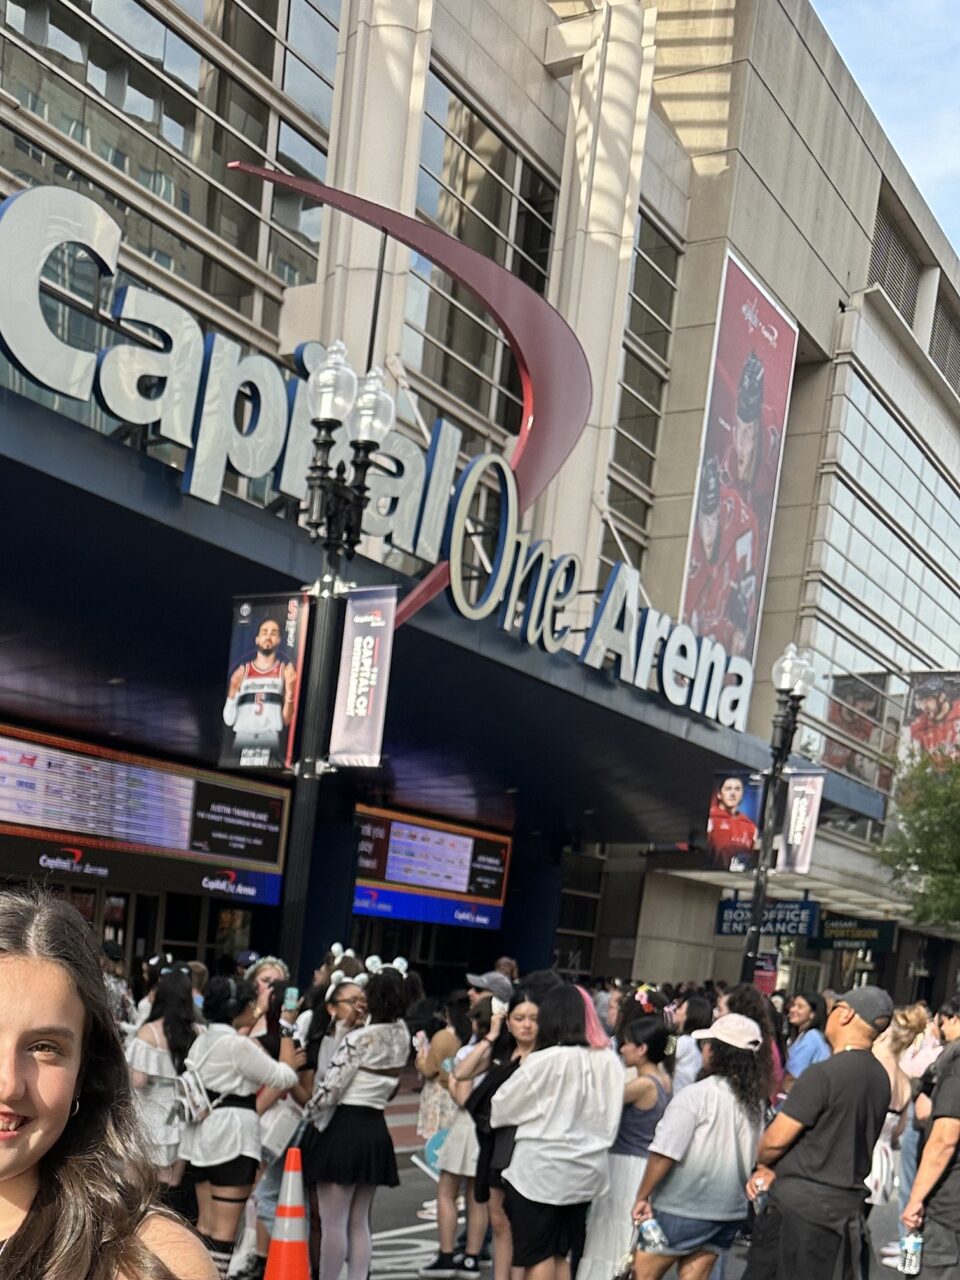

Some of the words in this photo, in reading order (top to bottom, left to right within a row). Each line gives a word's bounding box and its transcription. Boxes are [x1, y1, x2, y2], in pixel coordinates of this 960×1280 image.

[578, 560, 753, 732] Arena
[357, 635, 374, 695] CAPITAL
[254, 692, 265, 716] 5
[355, 695, 368, 717] OF
[236, 883, 257, 896] Arena
[722, 909, 752, 921] BOX
[721, 922, 808, 934] ENTANCE
